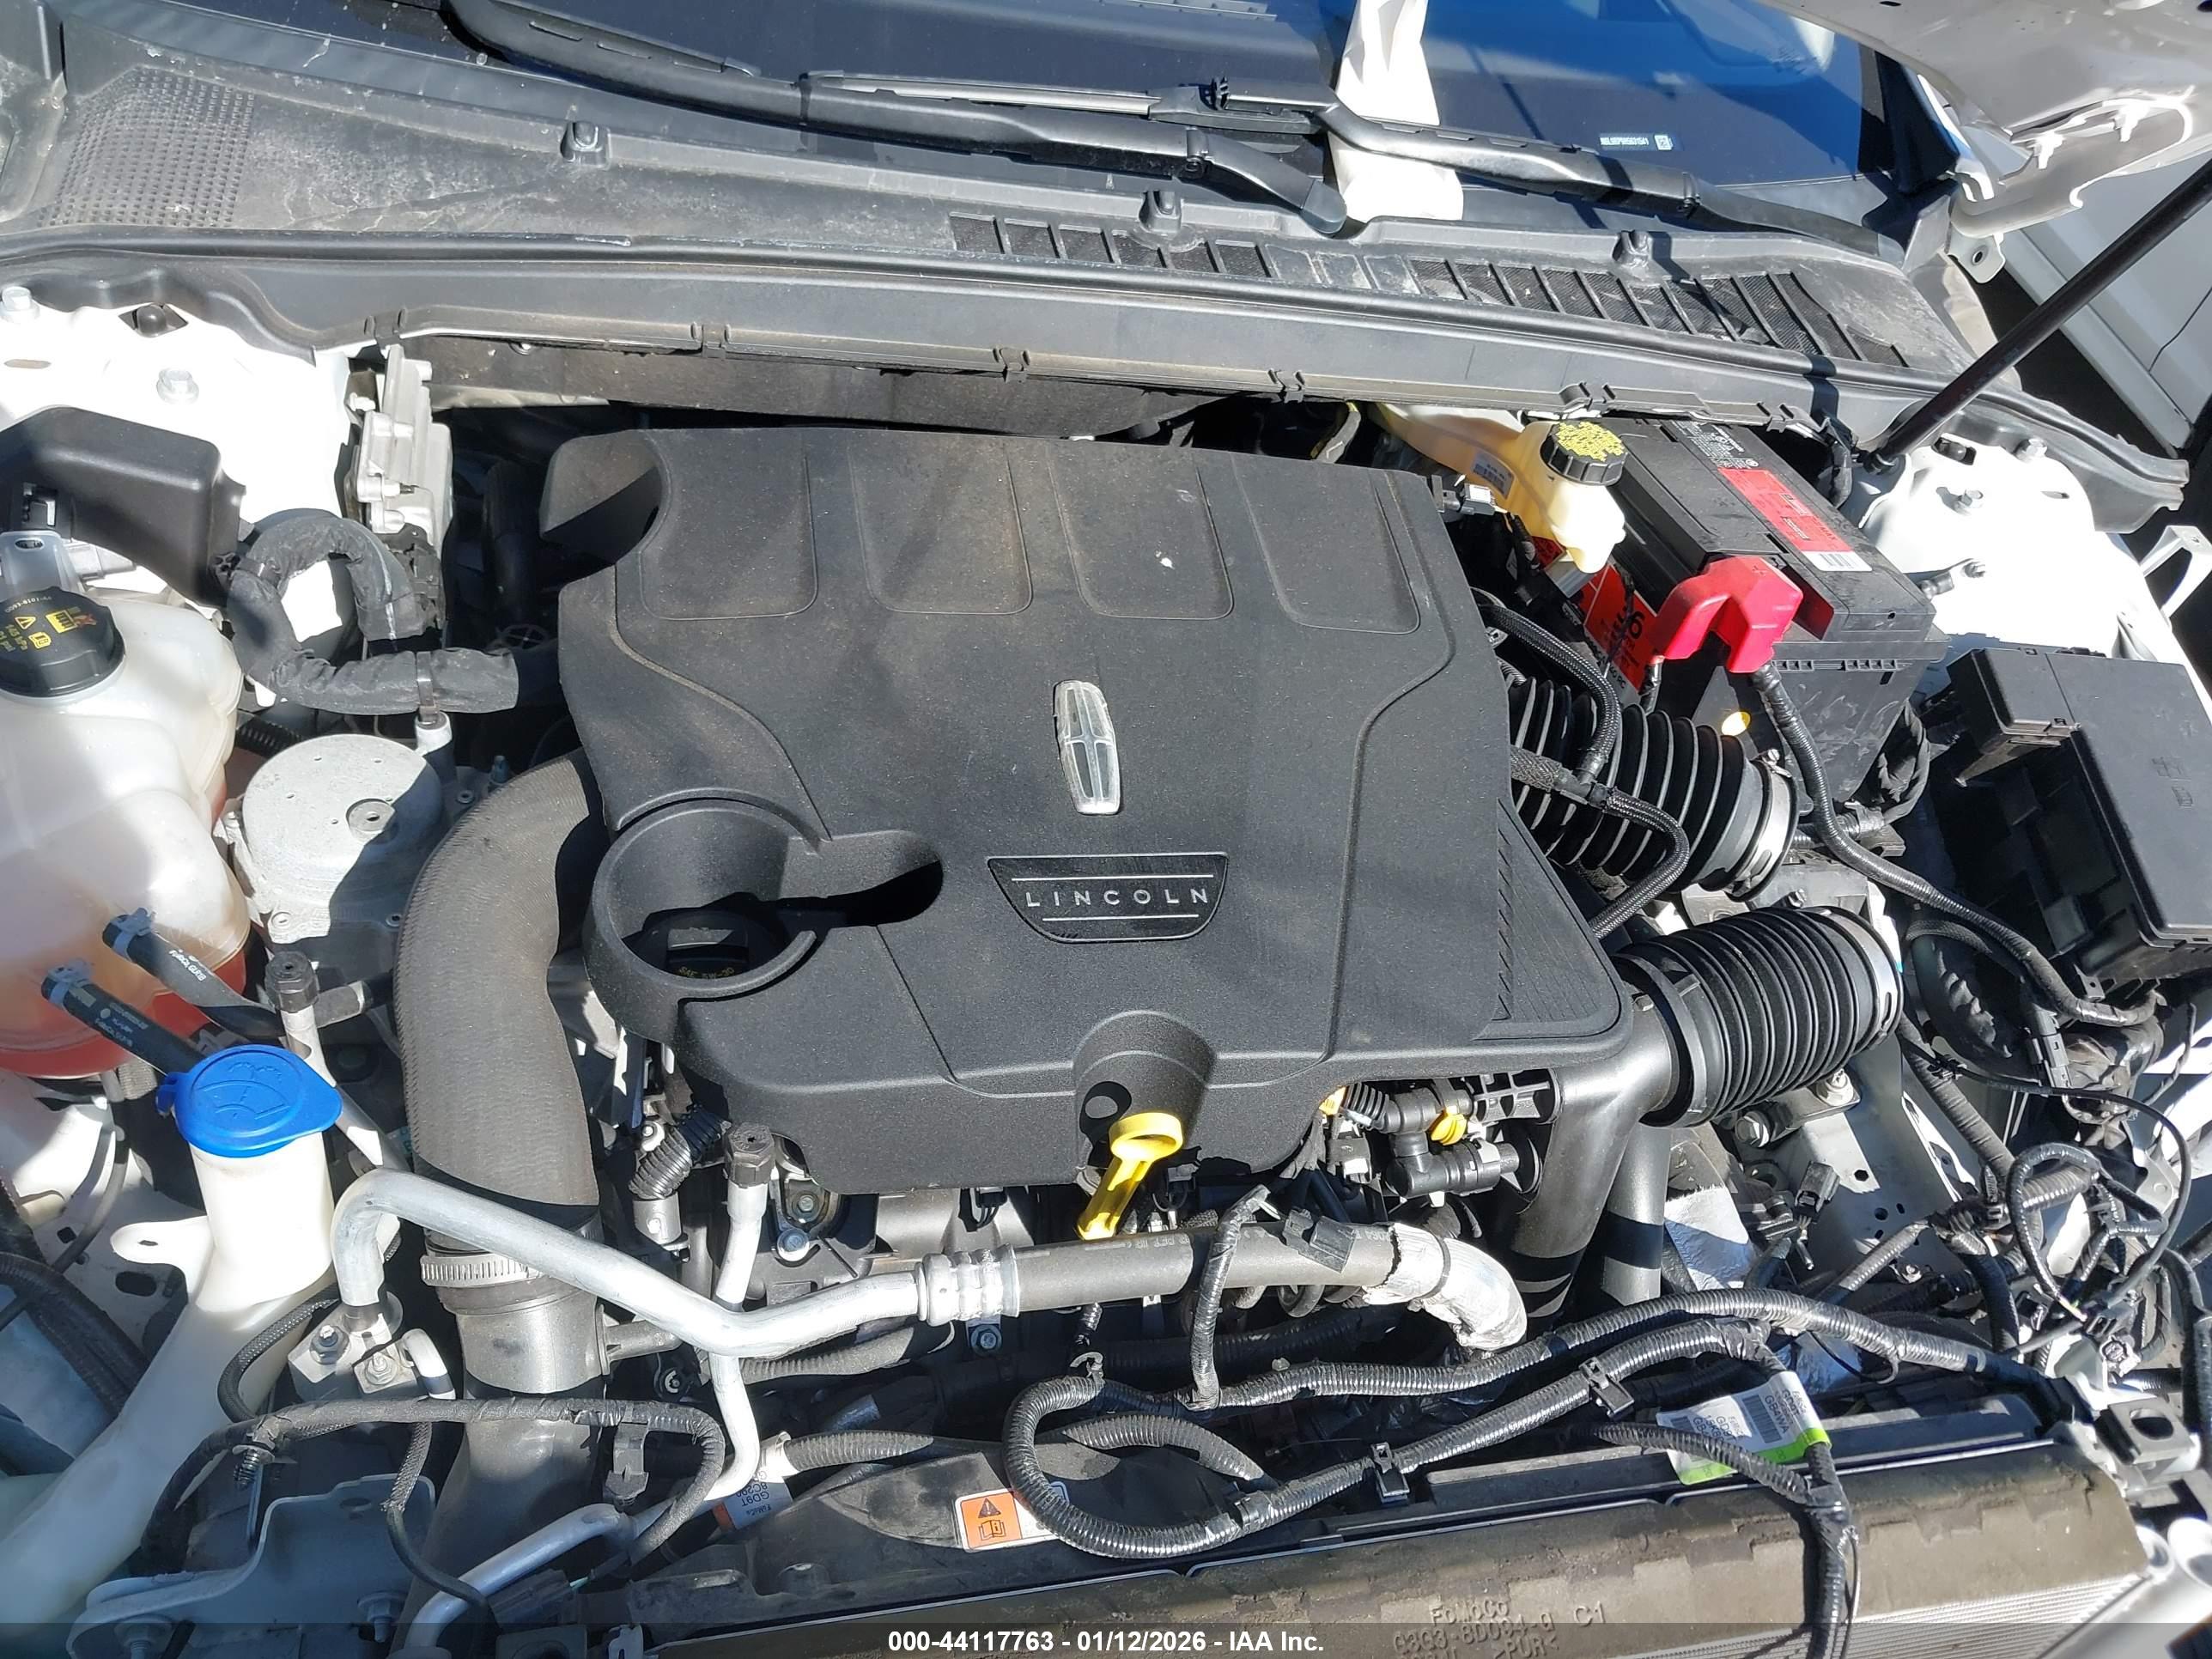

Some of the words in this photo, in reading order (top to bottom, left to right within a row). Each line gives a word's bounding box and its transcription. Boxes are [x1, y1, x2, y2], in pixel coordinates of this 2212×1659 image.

[1025, 888, 1208, 907] LINCOLN
[1765, 1395, 1790, 1434] GB4WA
[741, 1491, 769, 1507] GD9T
